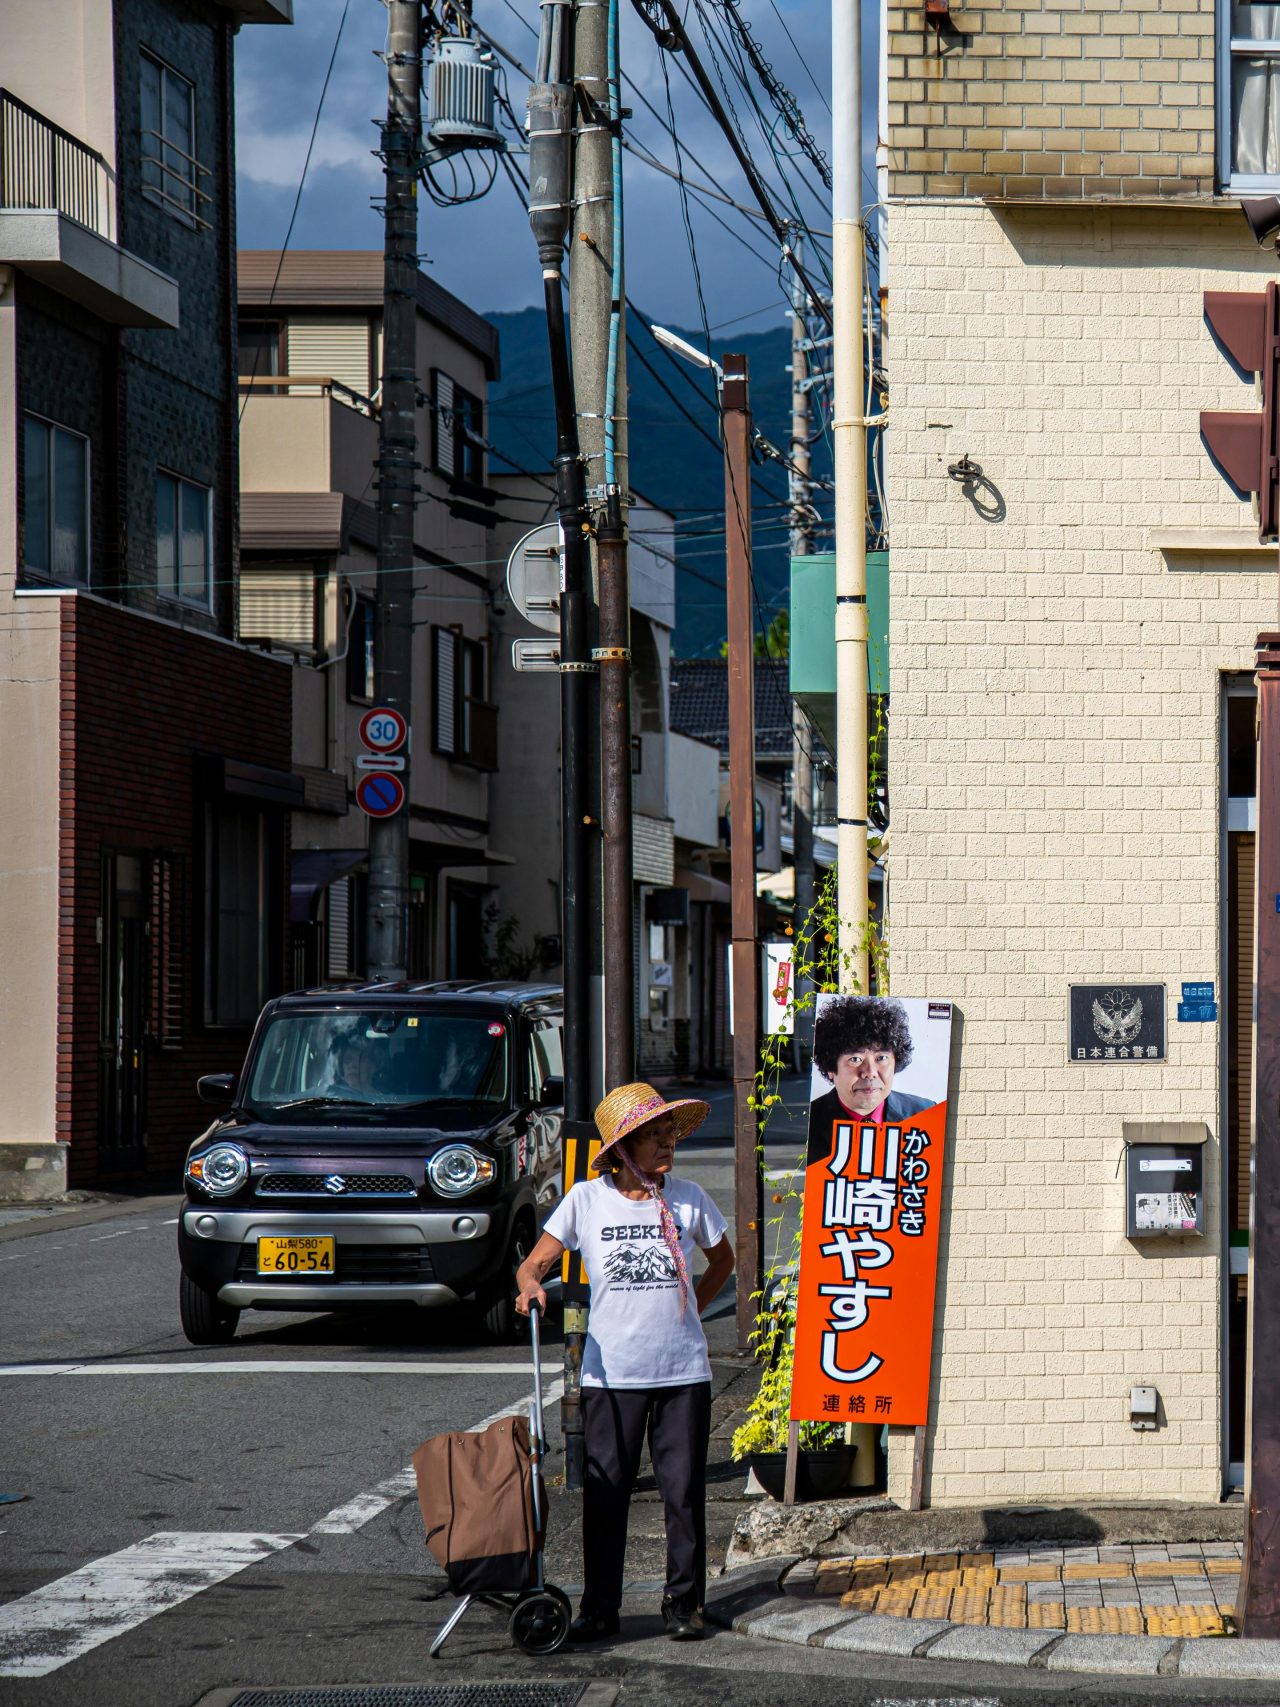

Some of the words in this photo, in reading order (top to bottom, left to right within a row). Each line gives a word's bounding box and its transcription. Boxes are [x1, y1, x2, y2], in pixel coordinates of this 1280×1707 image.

[369, 719, 397, 742] 30
[1076, 1045, 1159, 1059] 日本連合警備
[899, 1128, 931, 1236] かわさき
[275, 1251, 331, 1271] 60-54
[820, 1124, 899, 1383] 川崎やすし
[822, 1393, 893, 1415] 連絡所
